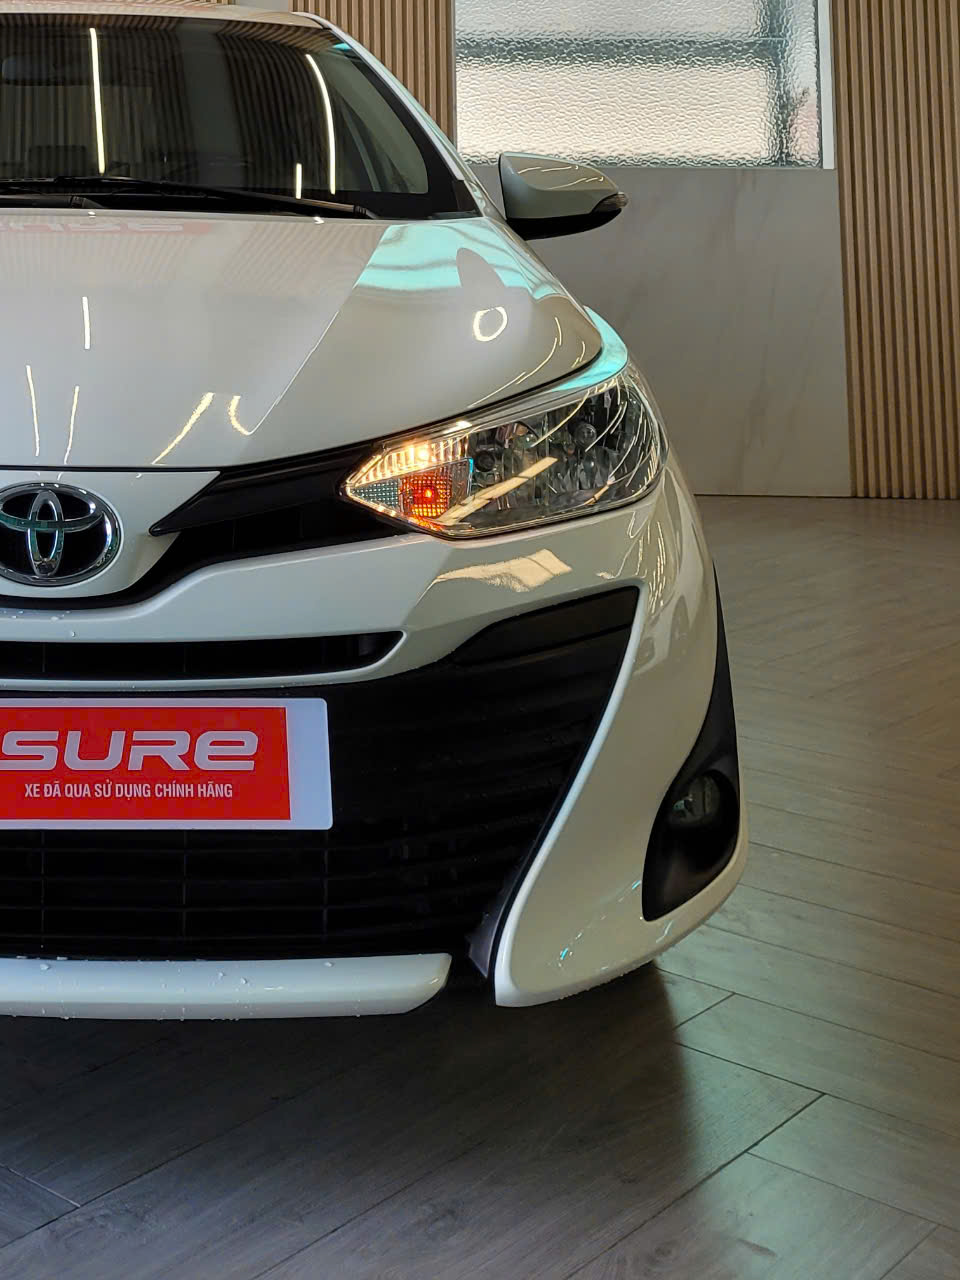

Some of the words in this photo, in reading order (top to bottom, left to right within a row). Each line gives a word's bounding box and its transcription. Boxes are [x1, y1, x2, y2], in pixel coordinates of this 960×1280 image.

[24, 784, 41, 798] XE
[43, 780, 62, 798] ĐÃ
[65, 784, 91, 798] QUA
[95, 780, 113, 798] SỬ
[115, 784, 151, 801] DỤNG
[155, 780, 194, 798] CHÍNH
[198, 781, 233, 798] HÃNG
